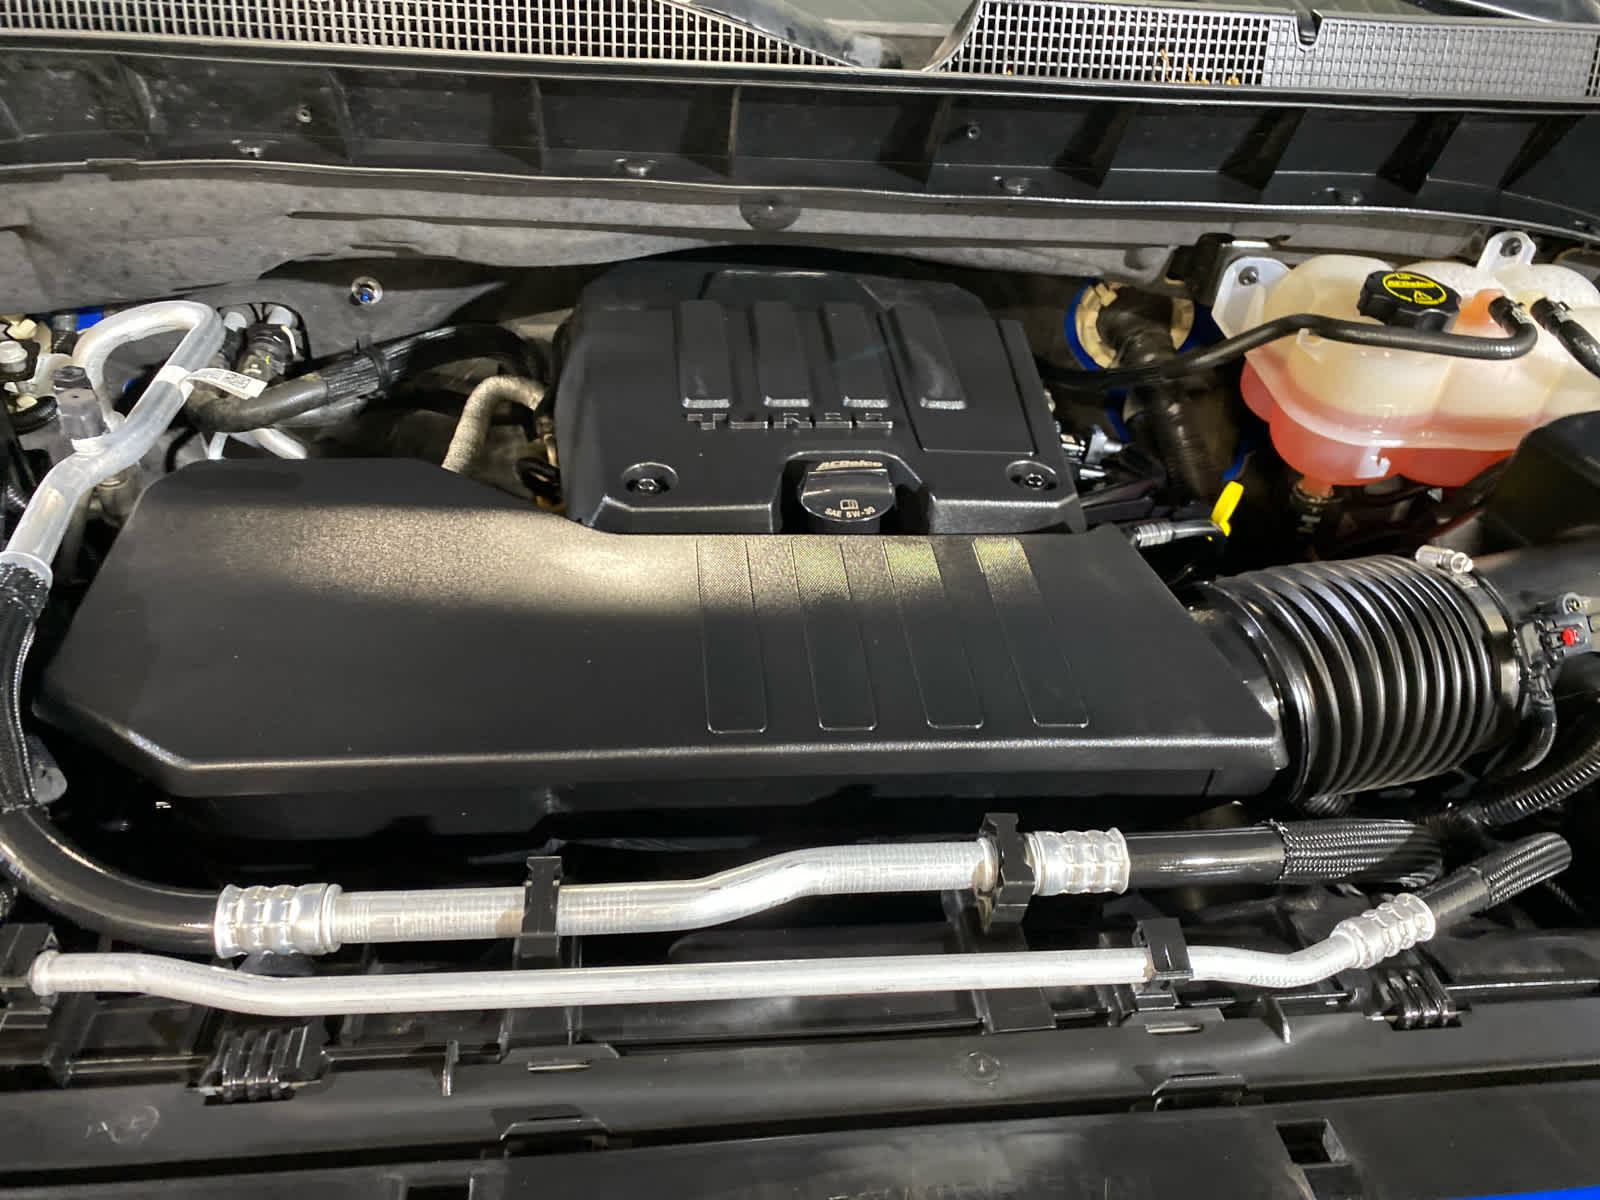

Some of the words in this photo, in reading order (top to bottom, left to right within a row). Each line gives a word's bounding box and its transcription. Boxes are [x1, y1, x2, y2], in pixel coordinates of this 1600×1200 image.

[685, 412, 894, 432] TURBO
[815, 459, 883, 471] ACDelco
[824, 507, 842, 518] SAE
